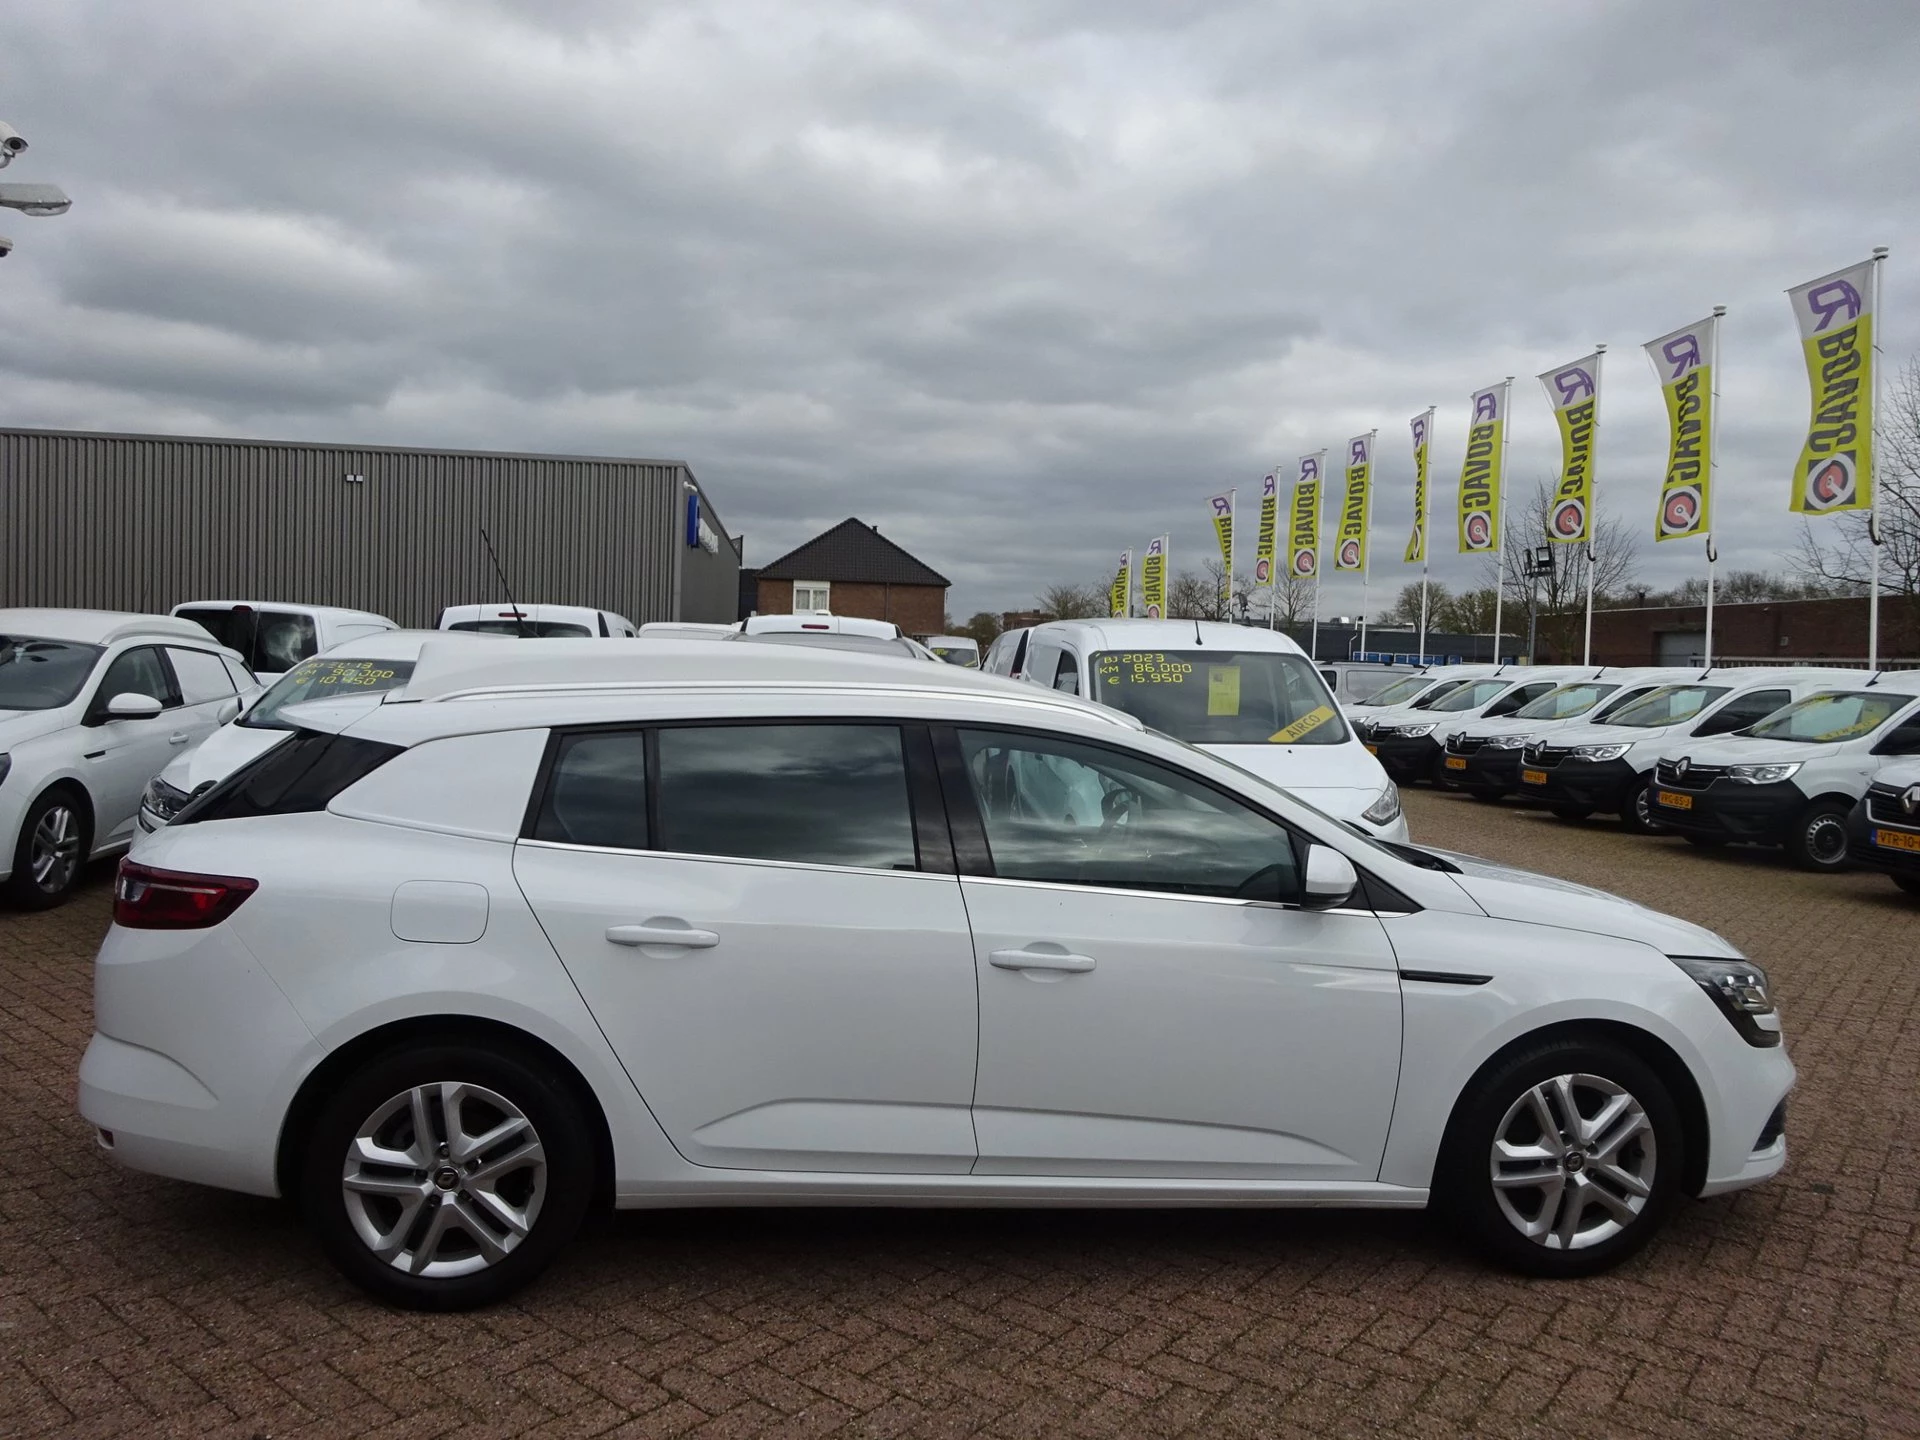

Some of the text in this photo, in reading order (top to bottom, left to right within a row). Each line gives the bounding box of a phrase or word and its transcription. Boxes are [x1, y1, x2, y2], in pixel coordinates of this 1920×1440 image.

[1122, 653, 1165, 663] 2023
[1099, 663, 1192, 674] KM 86.000
[1107, 673, 1183, 685] € 15.950
[1286, 714, 1321, 739] AIRCO
[1879, 832, 1920, 850] VTR-10-
